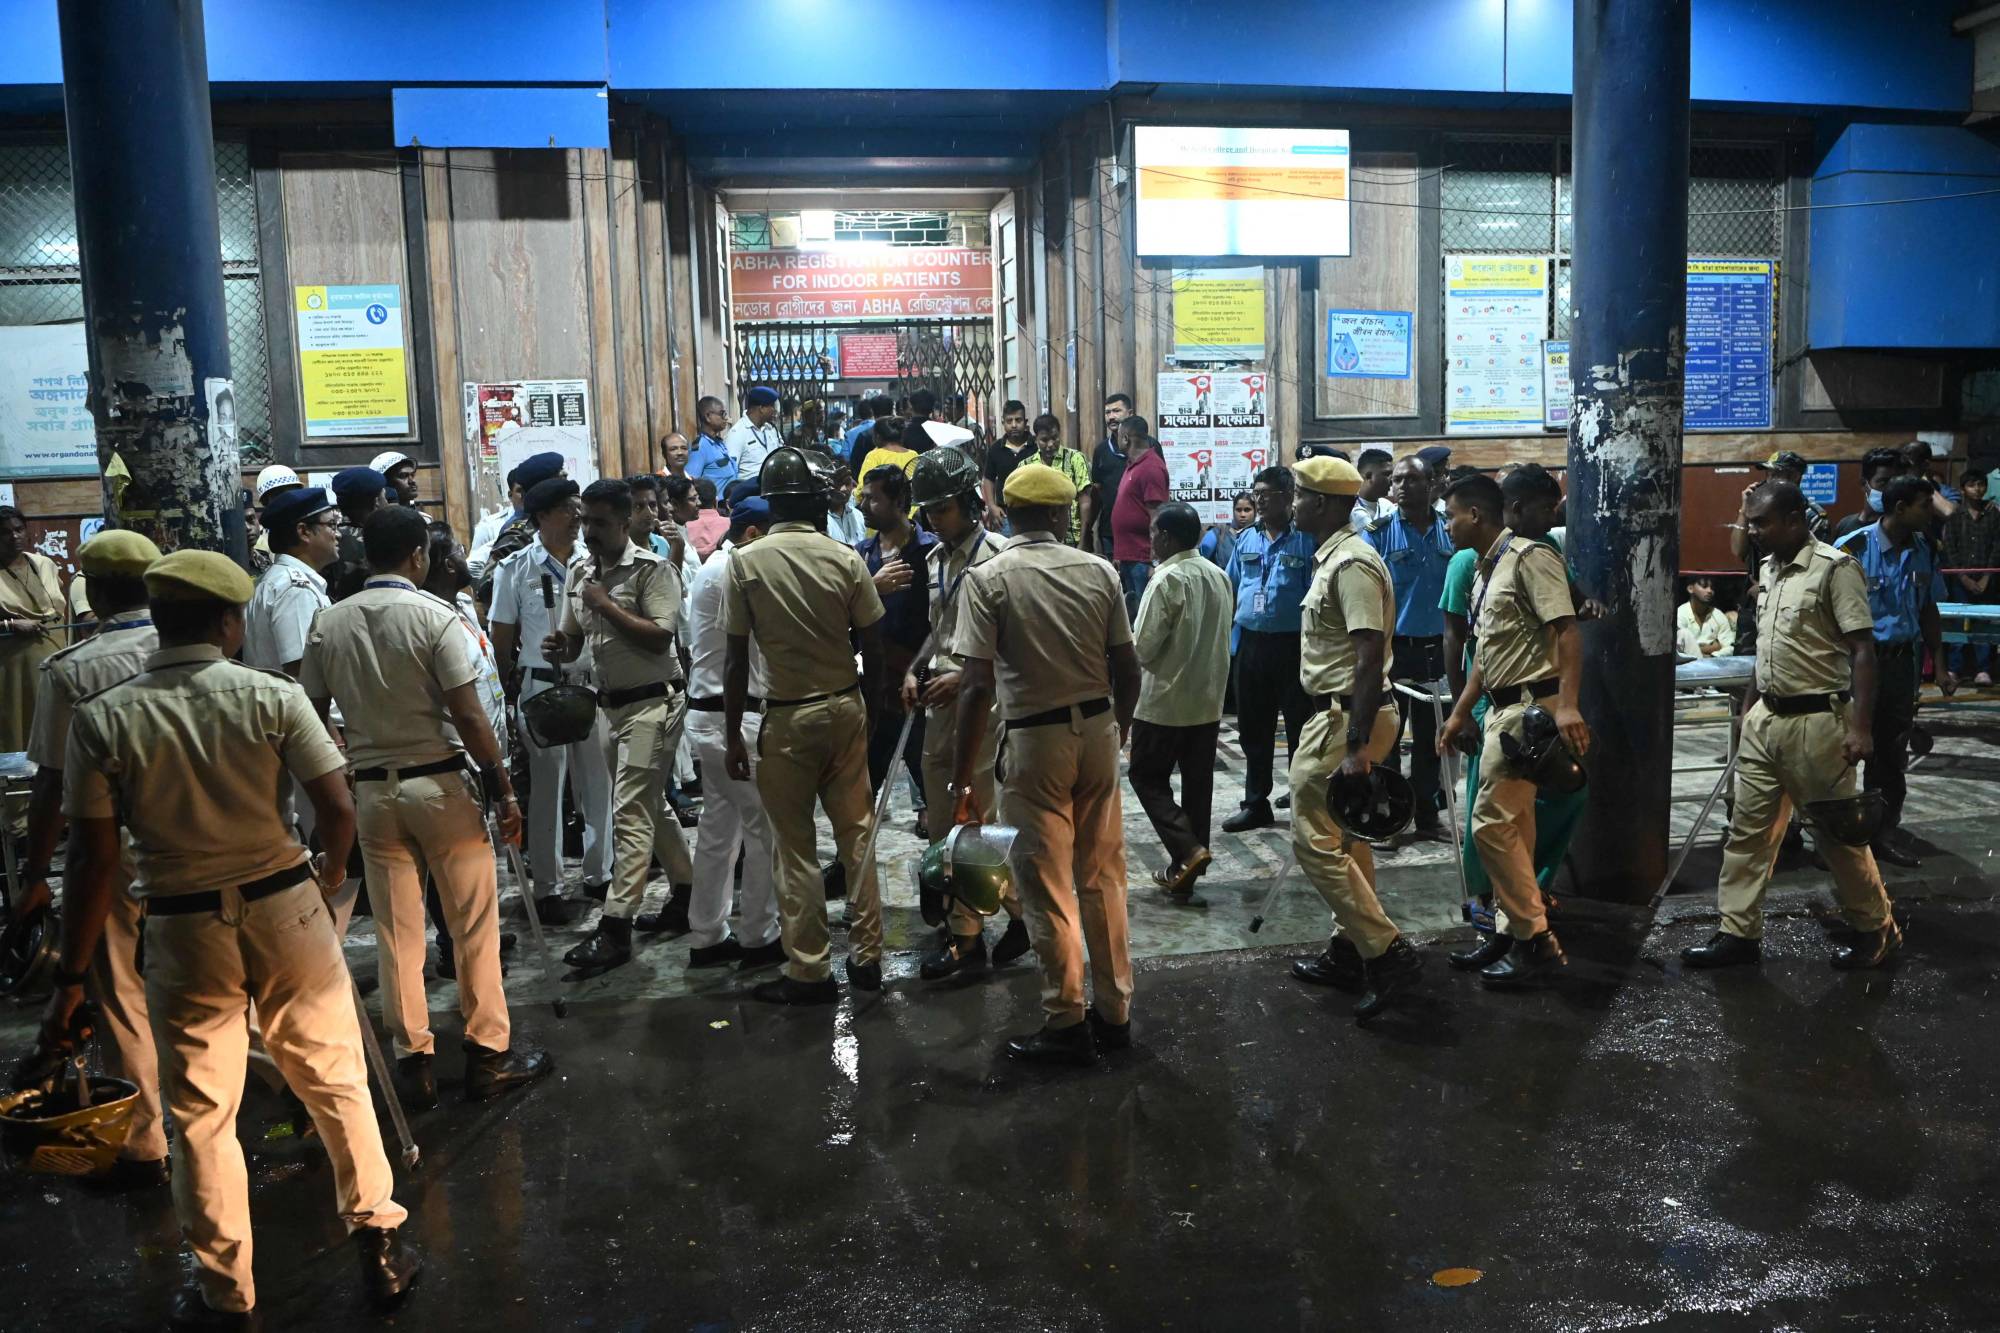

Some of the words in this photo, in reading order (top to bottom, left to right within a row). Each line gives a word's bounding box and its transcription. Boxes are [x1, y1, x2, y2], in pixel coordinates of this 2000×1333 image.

[732, 255, 781, 270] ABHA
[785, 253, 907, 269] REGISTRATION
[912, 251, 993, 266] COUNTER
[772, 275, 808, 289] FOR
[812, 273, 878, 289] INDOOR
[883, 271, 961, 287] PATIENTS
[776, 295, 826, 316] রোগীদের
[830, 299, 857, 315] জন্য
[862, 298, 902, 314] ABHA
[25, 450, 98, 459] www.organdonat
